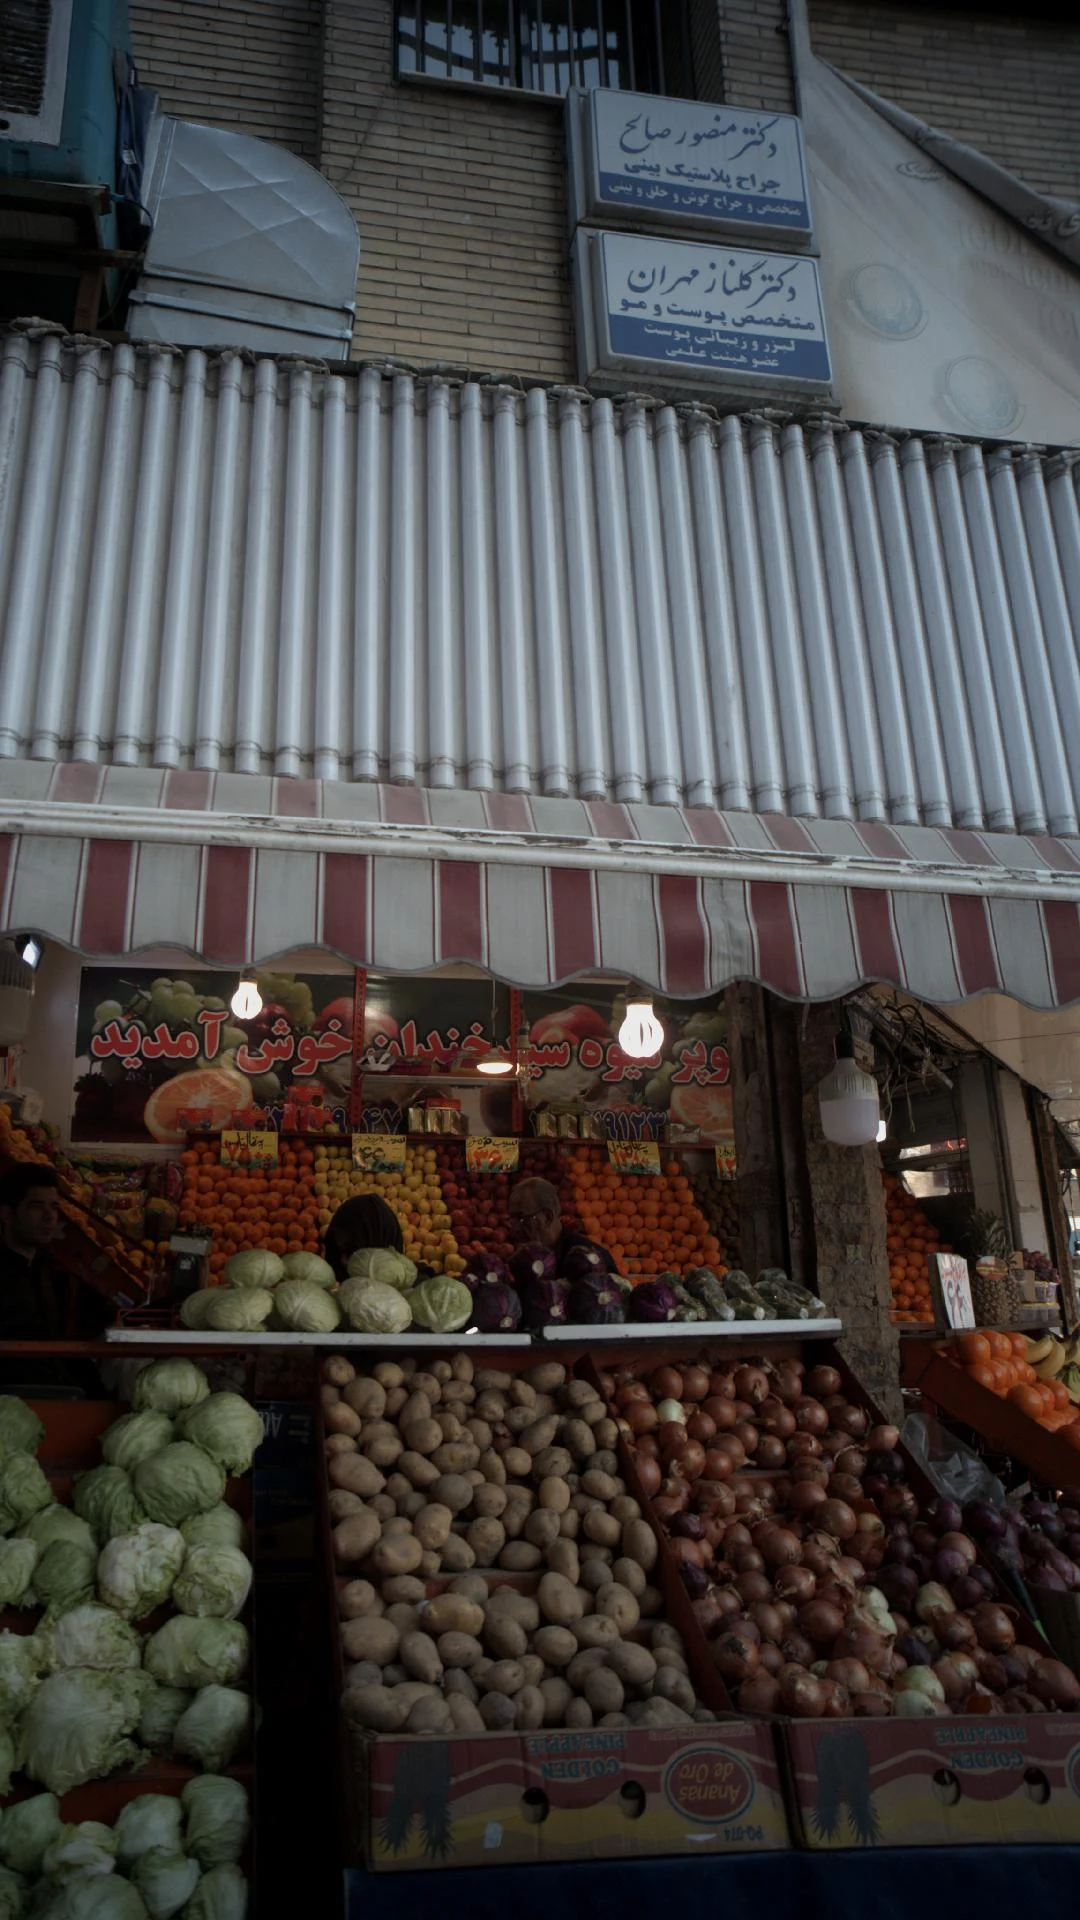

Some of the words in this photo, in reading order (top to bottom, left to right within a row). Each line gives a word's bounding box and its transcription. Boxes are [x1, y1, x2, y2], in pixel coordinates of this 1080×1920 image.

[619, 113, 671, 154] صالح
[675, 115, 737, 147] منصور
[728, 116, 781, 161] دکتر
[623, 158, 661, 177] بینی
[665, 164, 732, 189] پلاستیک
[736, 173, 781, 195] جراح
[626, 264, 700, 296] مهران
[703, 259, 768, 297] گلناز
[746, 260, 801, 310] دکتر
[619, 297, 649, 312] مو
[652, 301, 663, 317] و
[666, 304, 728, 327] پوست
[642, 320, 692, 342] پوست
[731, 310, 817, 332] متخصص
[750, 338, 760, 352] و
[762, 338, 797, 355] لیزر
[750, 352, 781, 368] عضو
[90, 1009, 229, 1070] آمدید
[236, 1018, 353, 1075] خوش
[670, 1040, 732, 1084] وپر
[527, 1732, 628, 1755] PINEAPPLE
[935, 1725, 1027, 1745] PINEAPPLE
[541, 1756, 621, 1779] GOLDEN
[951, 1749, 1024, 1769] GOLDEN
[680, 1762, 710, 1784] Oro
[713, 1760, 734, 1782] de
[679, 1784, 742, 1805] Ananas
